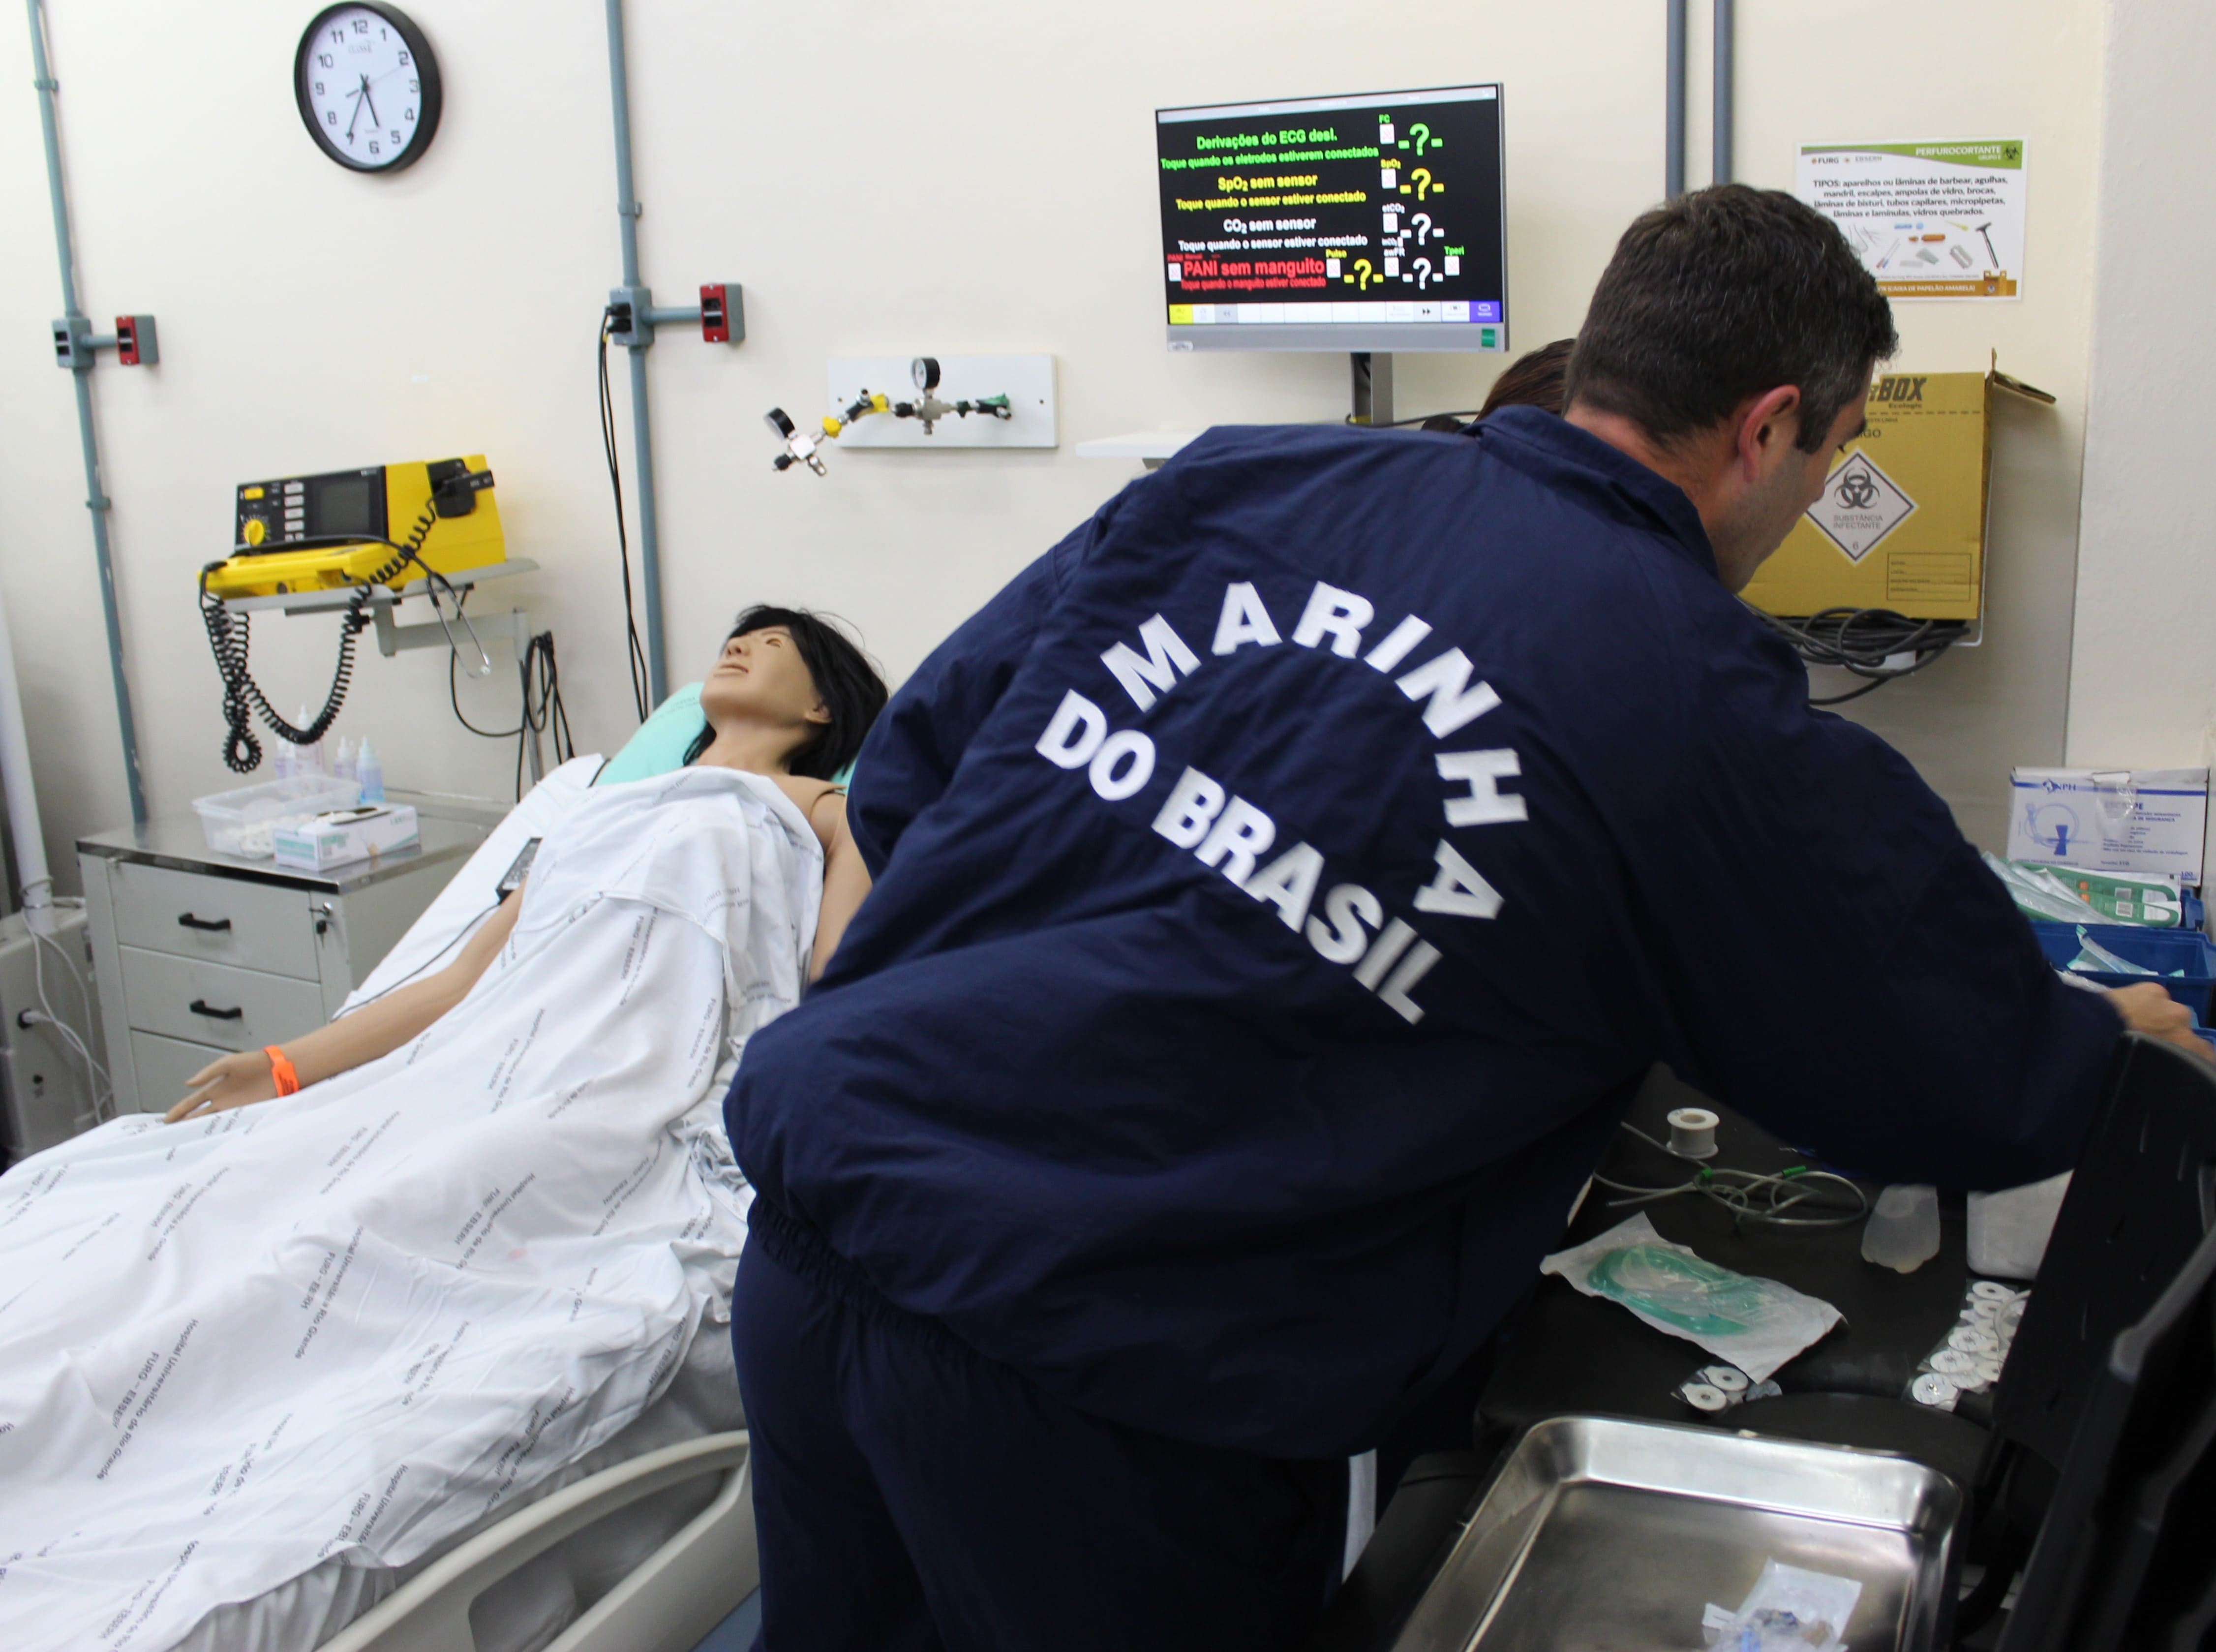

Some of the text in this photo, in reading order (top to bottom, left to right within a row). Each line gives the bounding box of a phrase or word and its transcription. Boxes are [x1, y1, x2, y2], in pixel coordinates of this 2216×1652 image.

[351, 20, 368, 34] 12
[331, 30, 344, 44] 11
[381, 28, 386, 42] 1
[317, 53, 334, 68] 10
[398, 51, 409, 65] 2
[315, 82, 325, 95] 9
[409, 79, 420, 93] 3
[328, 111, 337, 125] 8
[404, 107, 415, 122] 4
[1379, 114, 1390, 123] FC
[345, 130, 354, 145] 7
[391, 130, 401, 144] 5
[1196, 127, 1338, 150] Derivações do ECG desl.
[369, 141, 379, 154] 6
[1916, 145, 2002, 155] PERFUROCORTANTE
[1160, 146, 1379, 171] Toque quando os eletrodos estiverem conectados
[1250, 177, 1275, 188] sem
[1276, 175, 1318, 188] sensor
[1843, 178, 1881, 188] aparelhos
[1895, 177, 1926, 186] lâminas
[1928, 177, 1938, 185] de
[1940, 177, 1973, 185] barbear,
[1974, 176, 2008, 185] agulhas,
[1824, 189, 1855, 198] mandril,
[1857, 188, 1893, 197] escalpes,
[1895, 188, 1928, 197] ampolas
[1930, 187, 1940, 195] de
[1967, 186, 1996, 195] brocas,
[1176, 190, 1366, 212] Toque quando o sensor estiver conectado
[1814, 200, 1844, 208] lâminas
[1846, 199, 1856, 208] de
[1886, 198, 1909, 207] tubos
[1833, 210, 1863, 218] lâminas
[1913, 208, 1938, 216] vidros
[1249, 220, 1274, 232] sem
[1275, 218, 1316, 231] sensor
[1178, 234, 1368, 253] Toque quando o sensor estiver conectado
[1184, 257, 1325, 278] PANI sem manguito
[1100, 581, 1528, 919] MARINHA
[1035, 689, 1443, 1025] DO BRASIL
[455, 1211, 482, 1245] EBSERH
[172, 1318, 199, 1357] Hospital
[137, 1351, 160, 1381] FURG
[525, 1407, 543, 1438] FURG
[119, 1431, 132, 1447] Rio
[385, 1464, 409, 1498] Hospital
[351, 1492, 371, 1517] FURG
